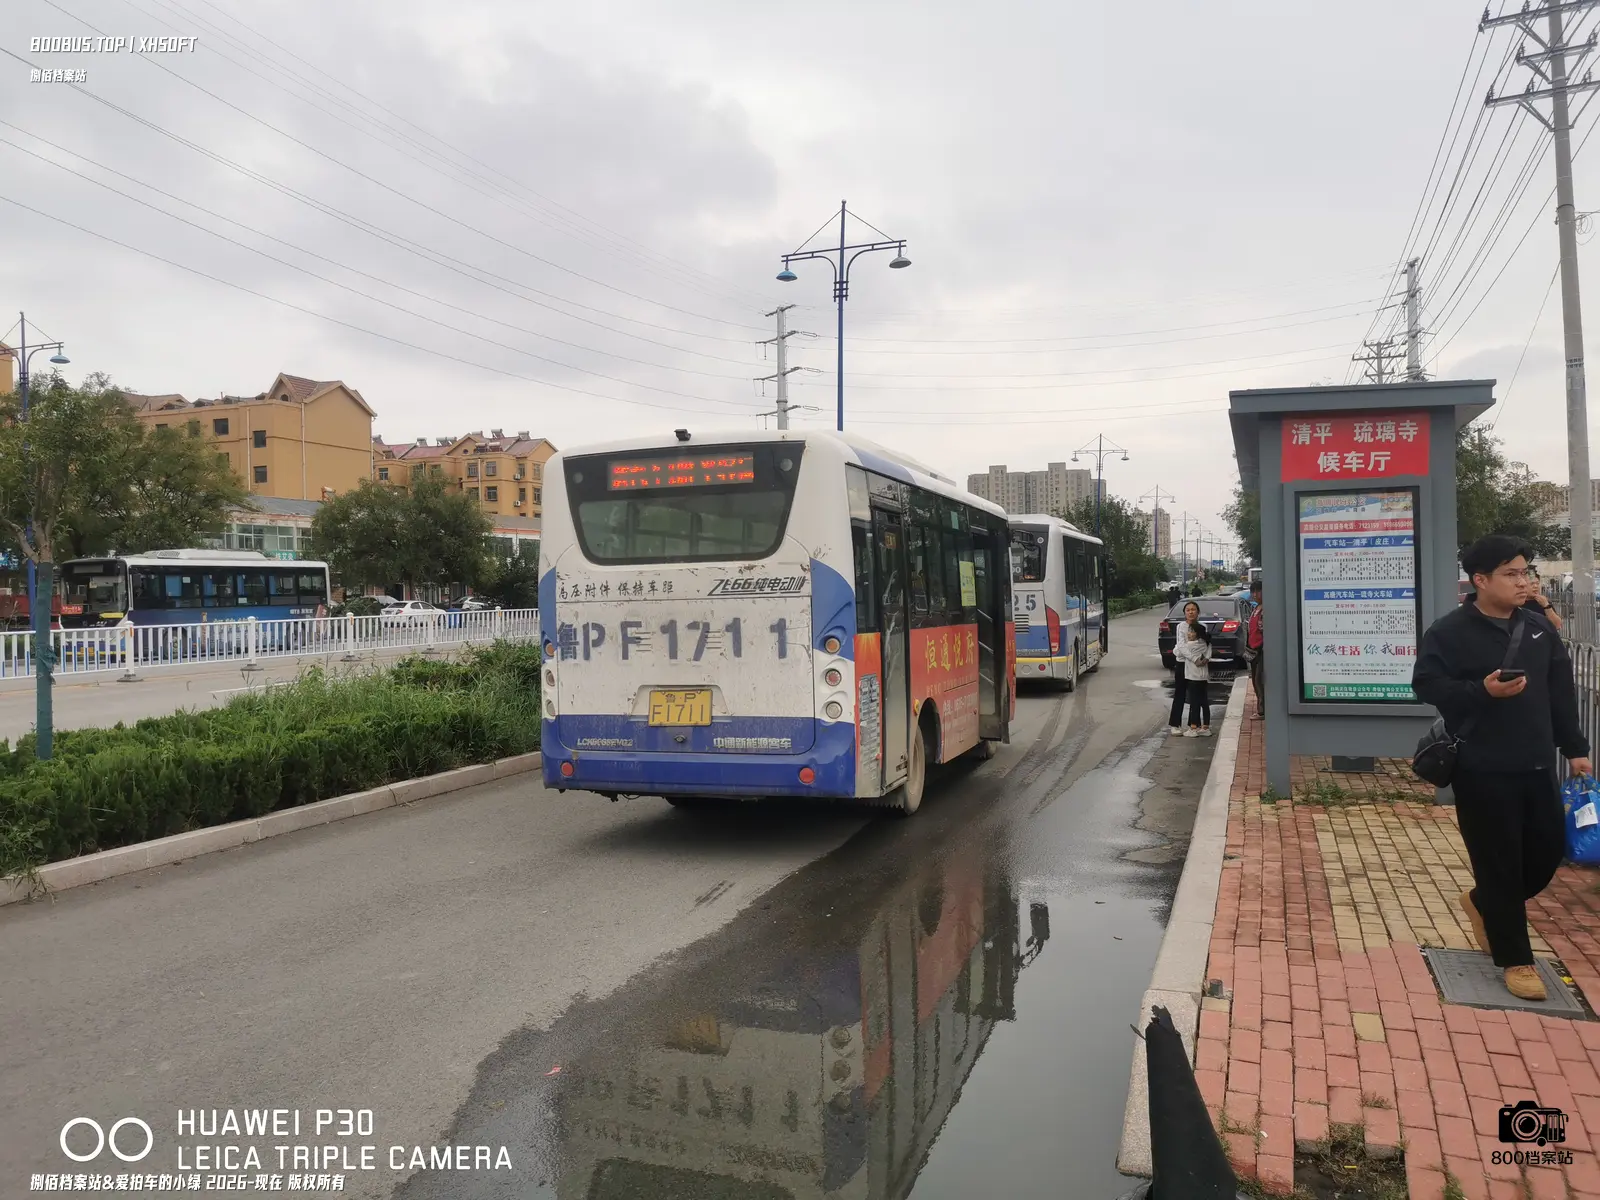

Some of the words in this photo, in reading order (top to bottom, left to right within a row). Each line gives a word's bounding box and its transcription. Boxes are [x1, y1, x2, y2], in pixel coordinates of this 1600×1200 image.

[1292, 422, 1333, 445] 清平
[1353, 420, 1418, 443] 琉璃寺
[1317, 450, 1391, 473] 候车厅
[557, 582, 611, 599] 高压附件
[617, 579, 675, 596] 保持车距
[1307, 643, 1361, 657] 低碳生活
[651, 704, 704, 722] F1711
[712, 737, 792, 750] 中通新能源客车
